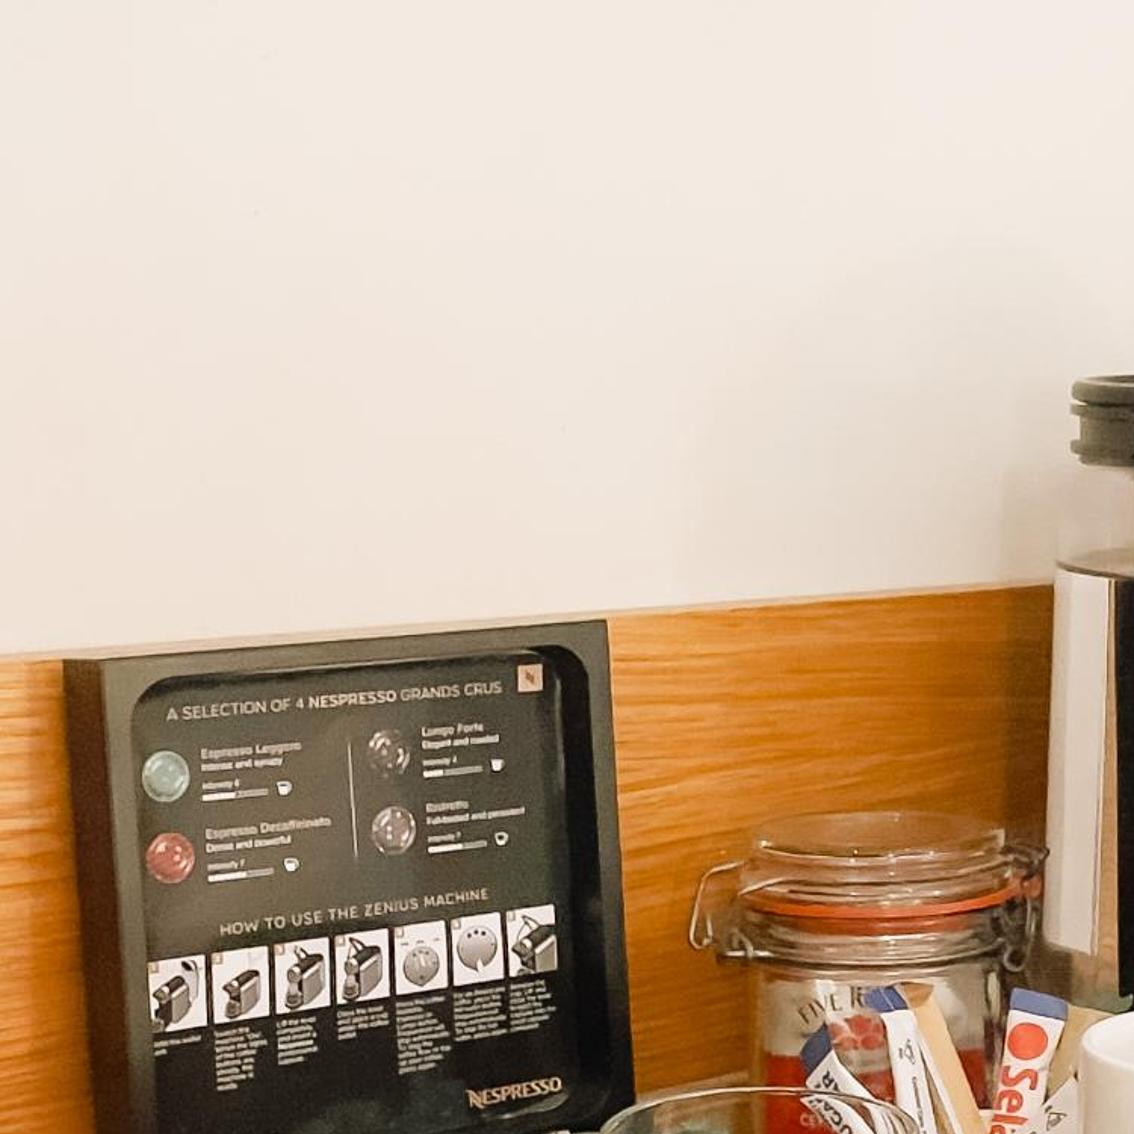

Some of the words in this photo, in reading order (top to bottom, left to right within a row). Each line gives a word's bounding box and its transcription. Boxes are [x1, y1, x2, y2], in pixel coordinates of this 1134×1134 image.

[166, 707, 179, 722] A
[182, 701, 267, 720] SELECTION
[270, 698, 291, 713] OF
[295, 699, 305, 709] 4
[308, 689, 397, 710] NESPRESSO
[400, 683, 460, 702] GRANDS
[463, 680, 503, 698] CRUS
[220, 919, 259, 937] HOW
[264, 915, 286, 930] TO
[291, 909, 322, 927] USE
[328, 905, 358, 921] THE
[364, 897, 419, 917] ZENIUS
[424, 888, 489, 908] MACHINE
[464, 1076, 563, 1110] NESPRESSO
